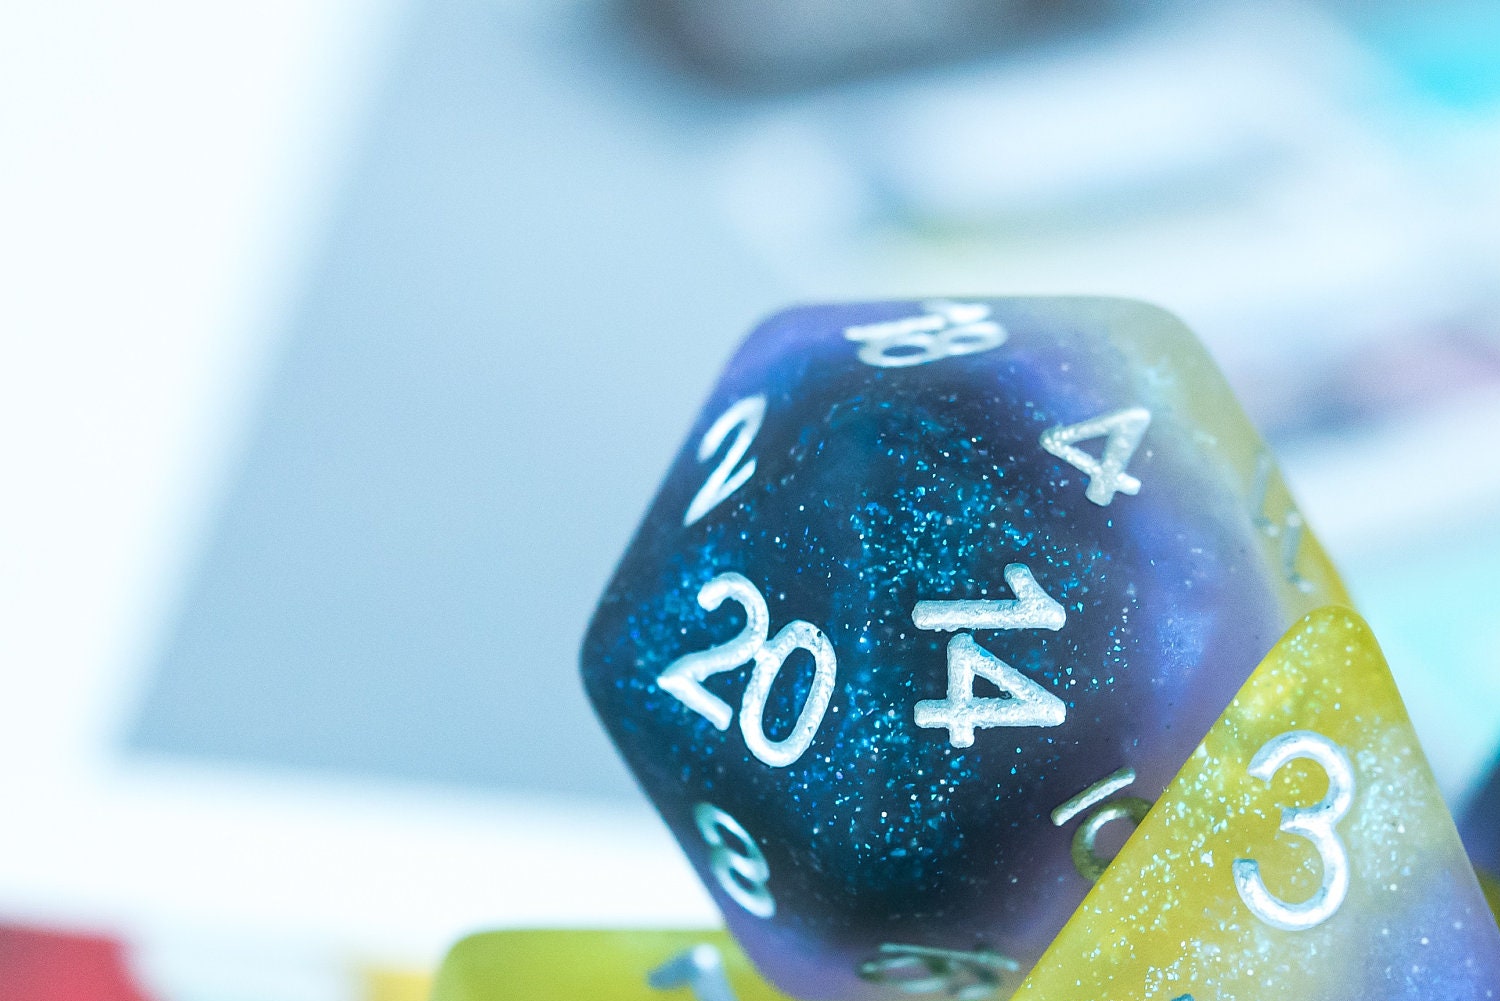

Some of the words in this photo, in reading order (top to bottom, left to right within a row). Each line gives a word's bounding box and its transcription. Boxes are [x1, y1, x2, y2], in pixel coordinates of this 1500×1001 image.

[683, 396, 766, 526] 2
[1040, 408, 1150, 506] 4
[657, 572, 837, 767] 20
[911, 563, 1066, 748] 14
[694, 802, 777, 918] 8
[1232, 729, 1355, 932] 3
